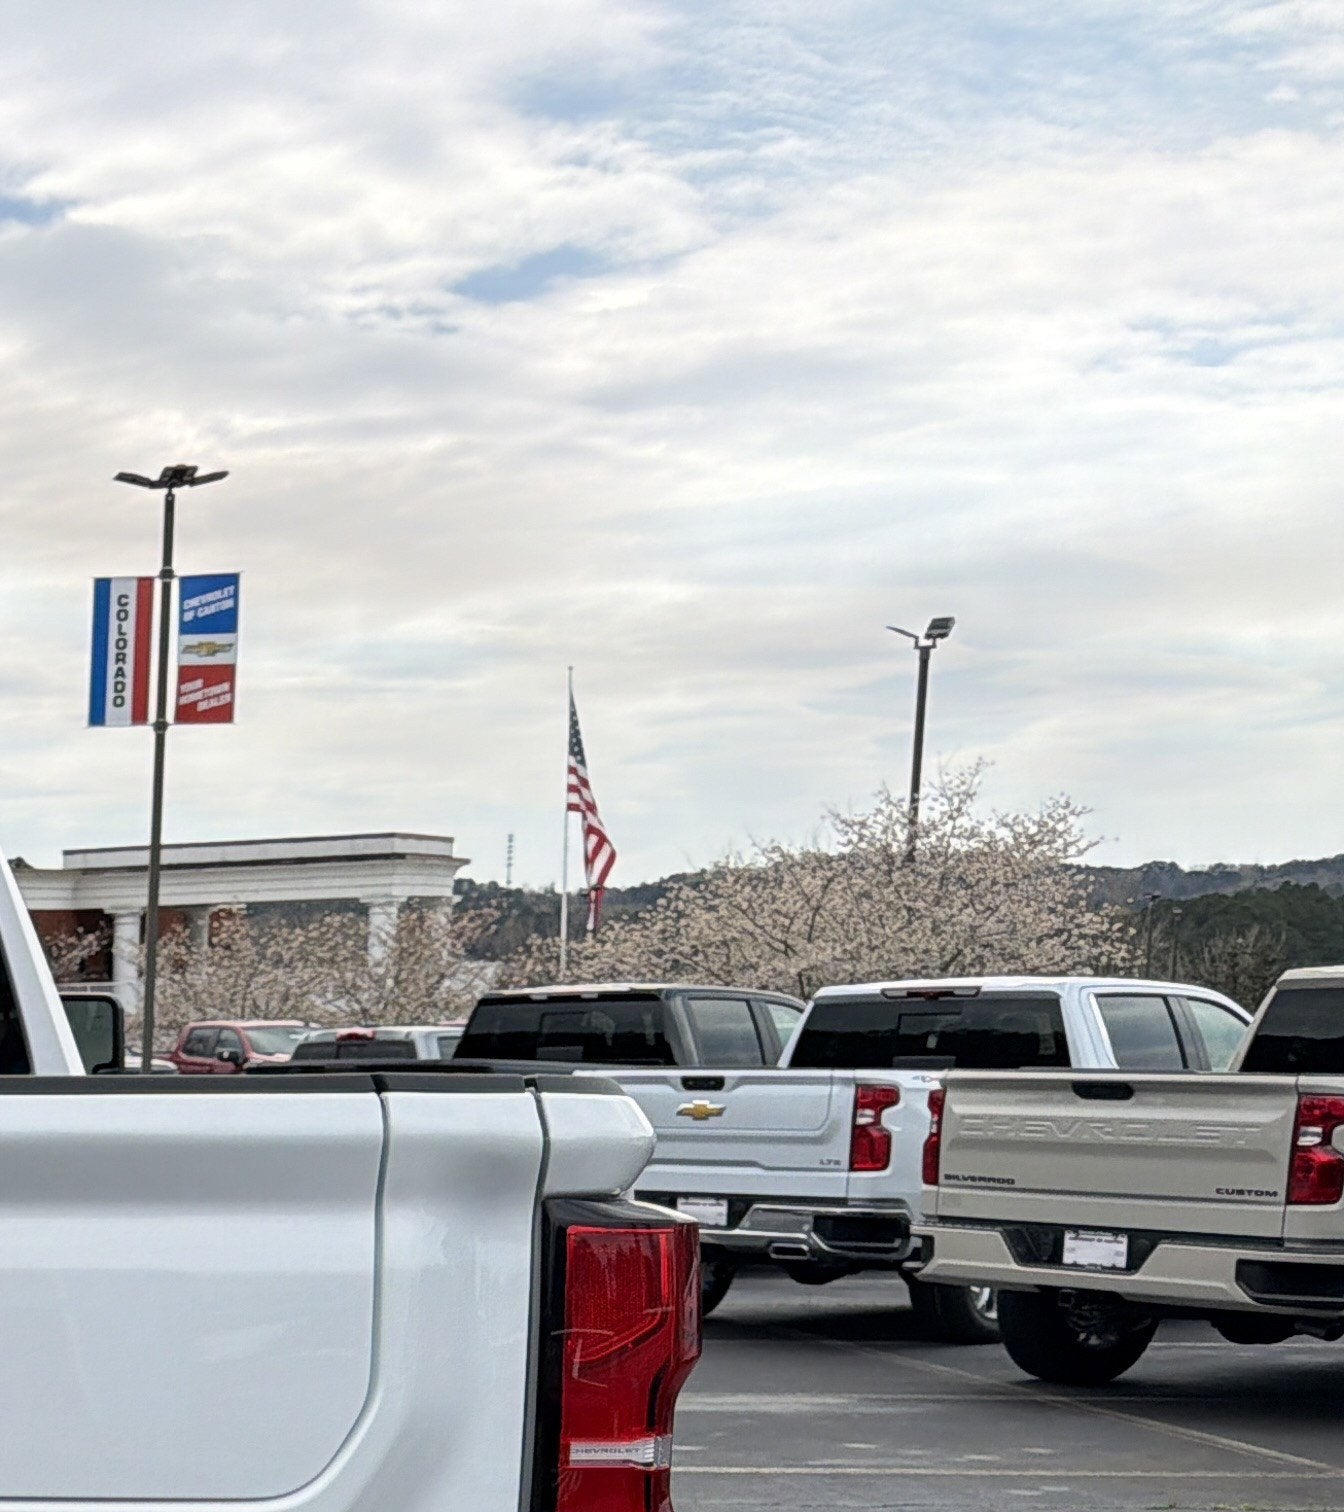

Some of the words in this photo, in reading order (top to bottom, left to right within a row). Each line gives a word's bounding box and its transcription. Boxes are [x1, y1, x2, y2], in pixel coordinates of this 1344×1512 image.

[112, 594, 129, 708] COLORADO
[960, 1118, 1262, 1145] CHEVROLET
[943, 1173, 1016, 1186] SILVERADO
[1215, 1186, 1279, 1199] CUSTOM
